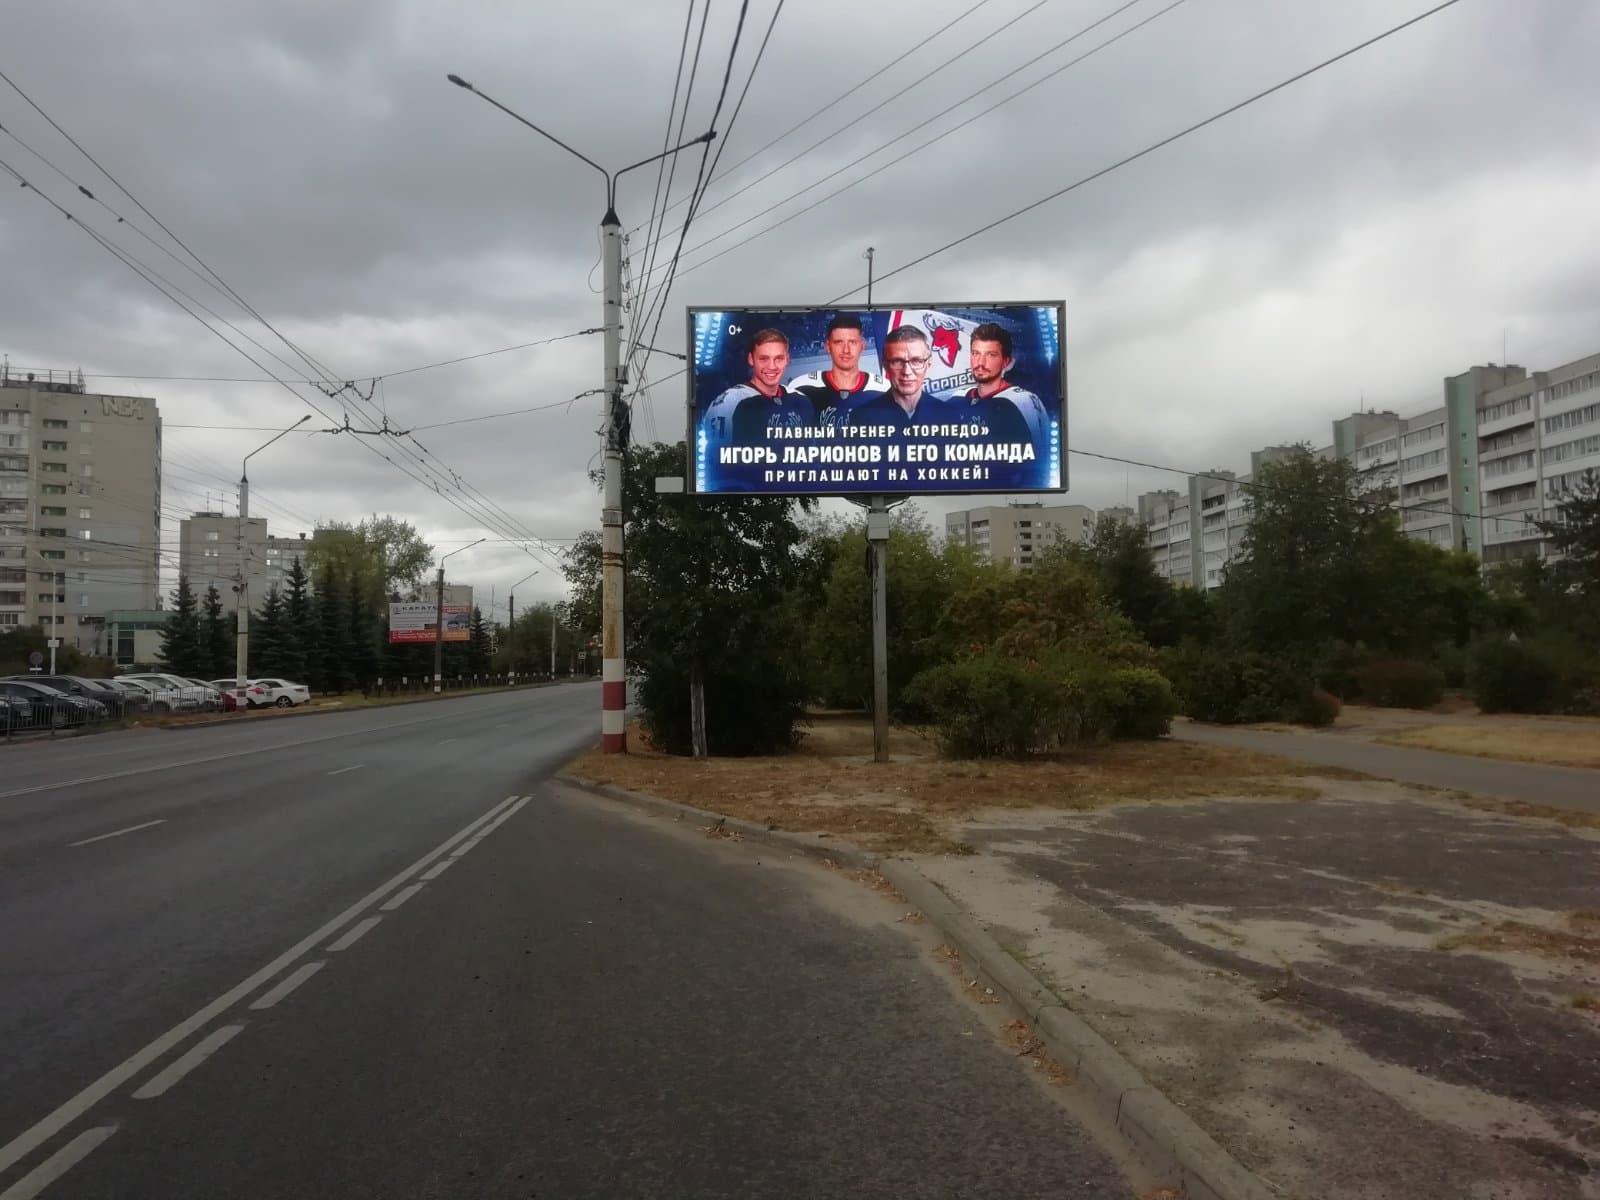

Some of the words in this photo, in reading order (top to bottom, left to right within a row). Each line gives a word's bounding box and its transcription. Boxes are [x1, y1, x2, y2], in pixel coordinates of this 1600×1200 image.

[728, 324, 743, 336] 0+
[766, 424, 836, 440] ГЛАВНЫЙ
[841, 425, 896, 439] ТРЕНЕР
[902, 424, 990, 439] «ТОРПЕДО»
[720, 445, 778, 465] ИГОРЬ
[782, 444, 882, 464] ЛАРИОНОВ
[887, 444, 900, 462] И
[906, 444, 938, 462] ЕГО
[944, 442, 1036, 464] КОМАНДА
[765, 468, 881, 482] ПРИГЛАШАЮТ
[888, 468, 908, 481] НА
[917, 465, 991, 481] ХОККЕЙ!
